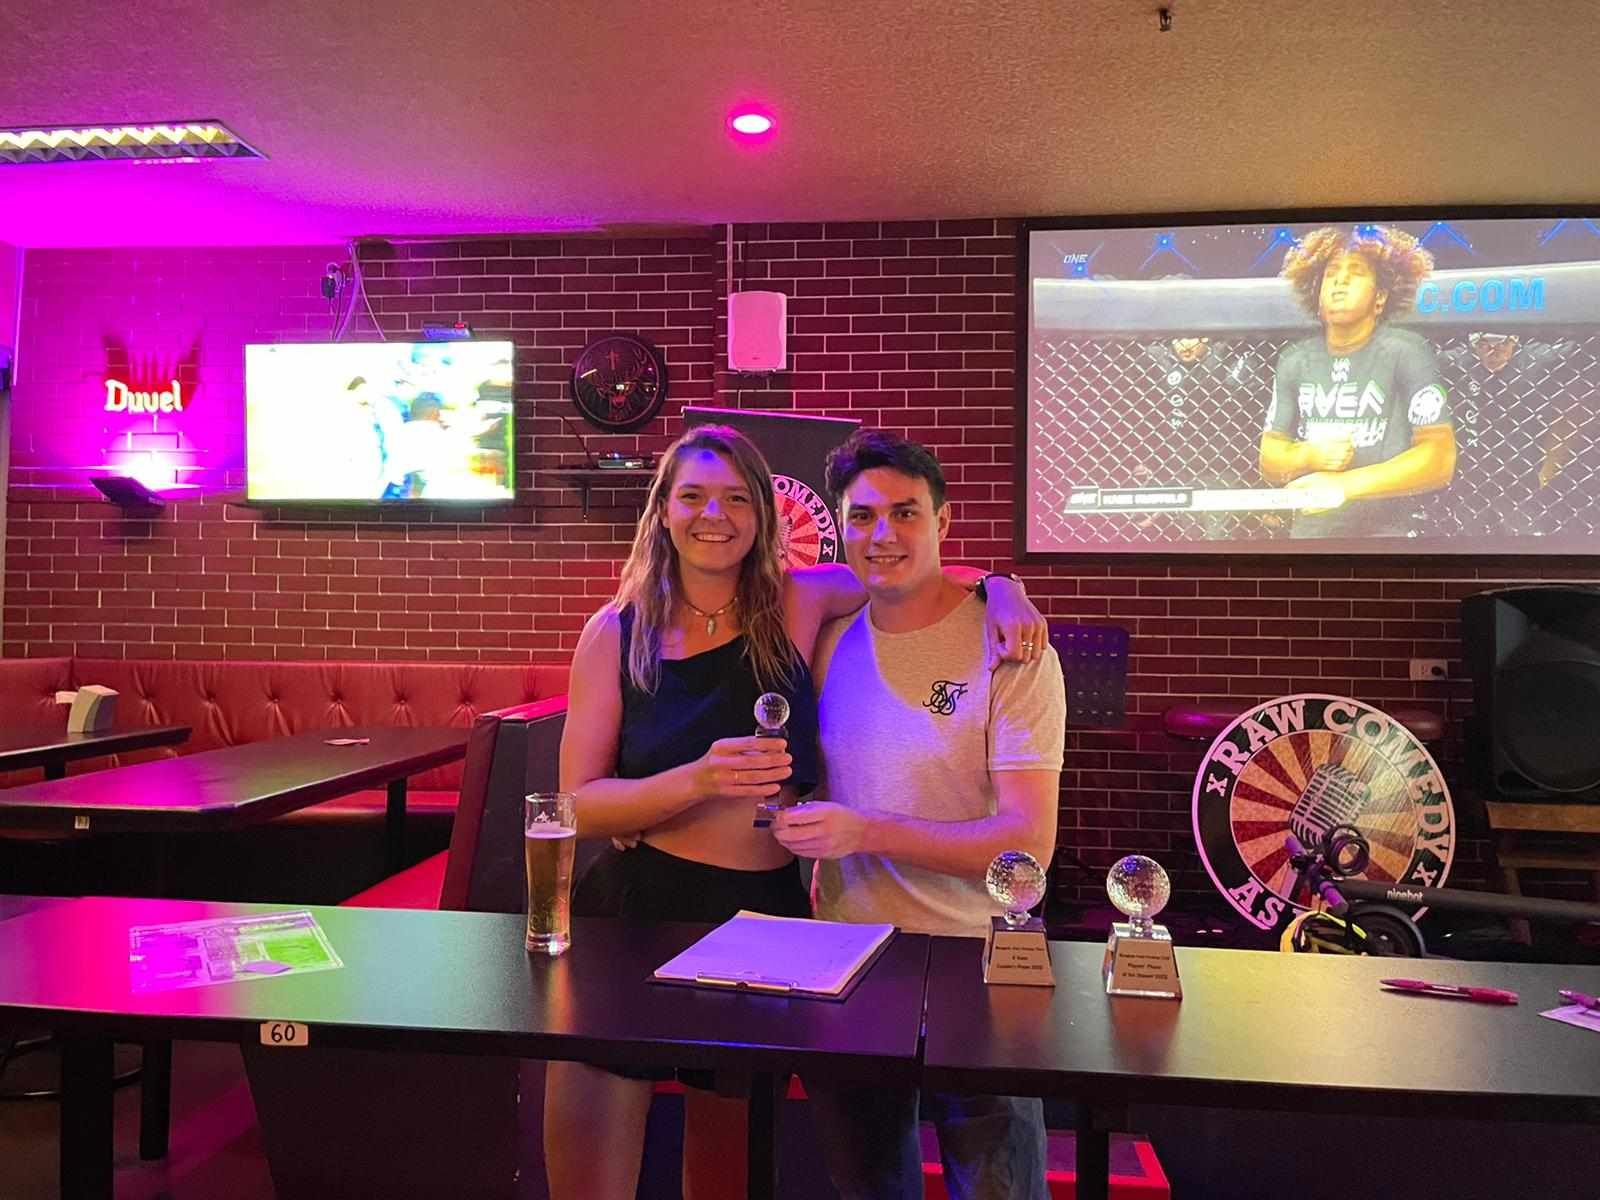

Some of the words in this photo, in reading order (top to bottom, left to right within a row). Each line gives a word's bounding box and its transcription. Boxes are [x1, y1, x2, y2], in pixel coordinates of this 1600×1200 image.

[1416, 277, 1545, 313] C.COM
[104, 379, 183, 414] Duvel
[773, 477, 836, 541] OMEDY
[1211, 699, 1308, 776] RAW
[1323, 701, 1451, 863] COMEDY
[1228, 876, 1304, 929] AS
[271, 1023, 296, 1043] 60
